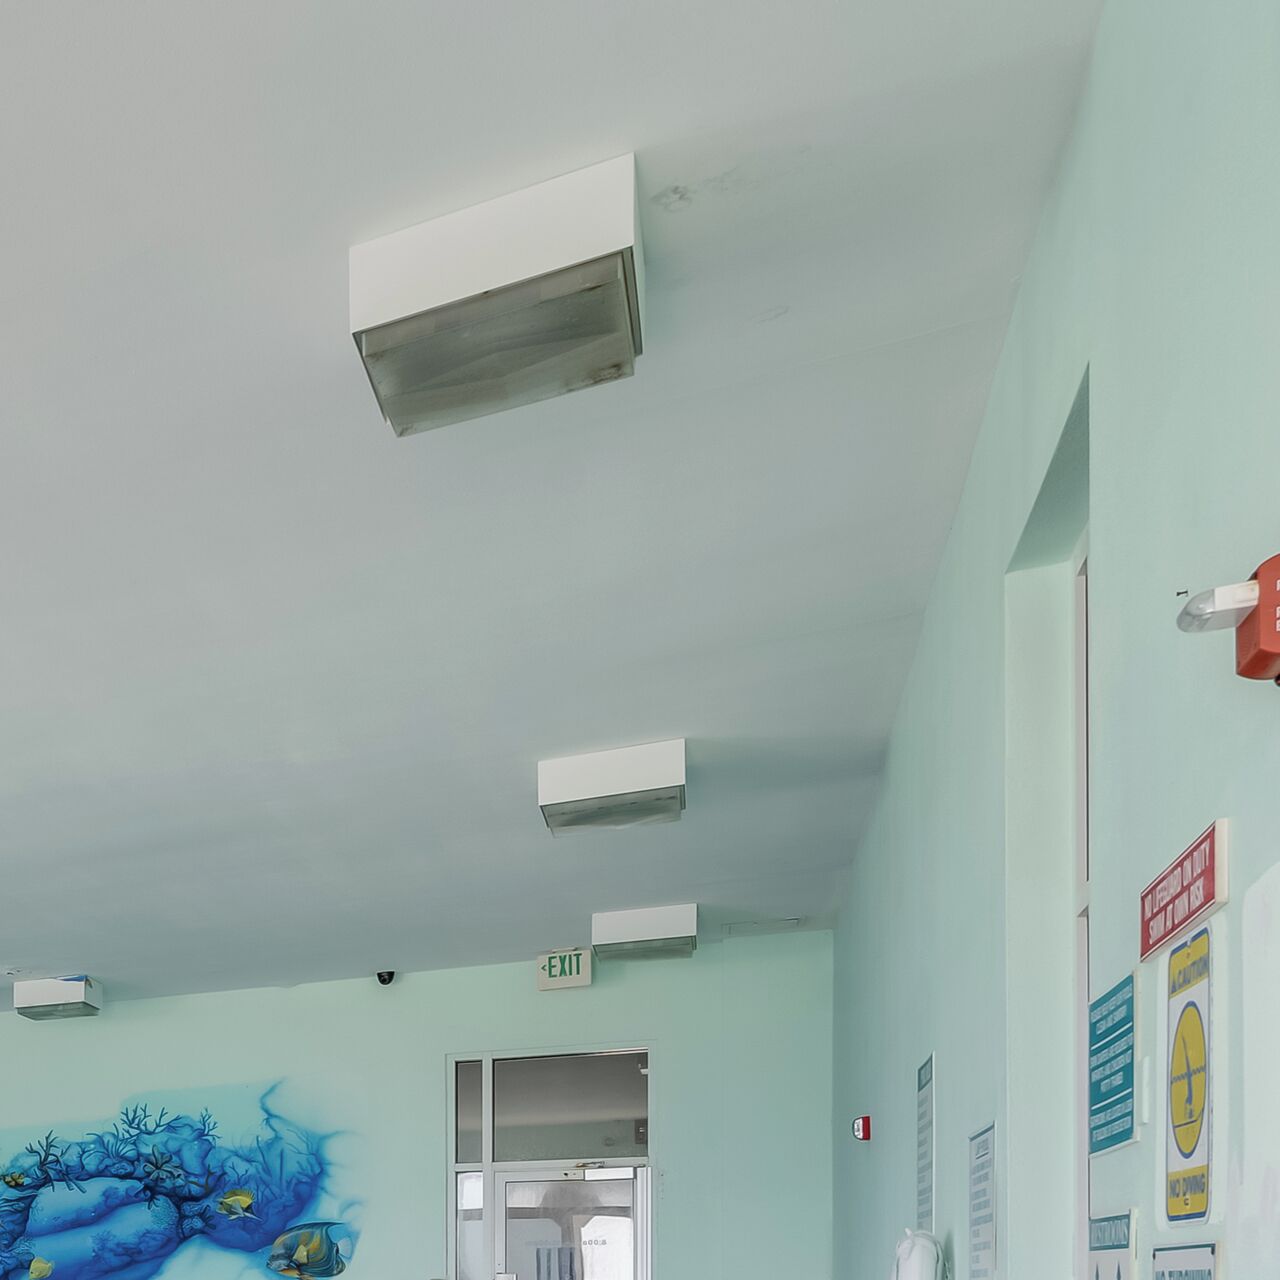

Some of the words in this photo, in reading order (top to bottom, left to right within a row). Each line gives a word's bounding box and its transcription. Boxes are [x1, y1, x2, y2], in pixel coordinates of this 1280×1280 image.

[548, 953, 582, 978] EXIT
[1177, 955, 1208, 988] CAUTION
[1170, 1178, 1180, 1198] NO
[1182, 1174, 1205, 1197] DIVING
